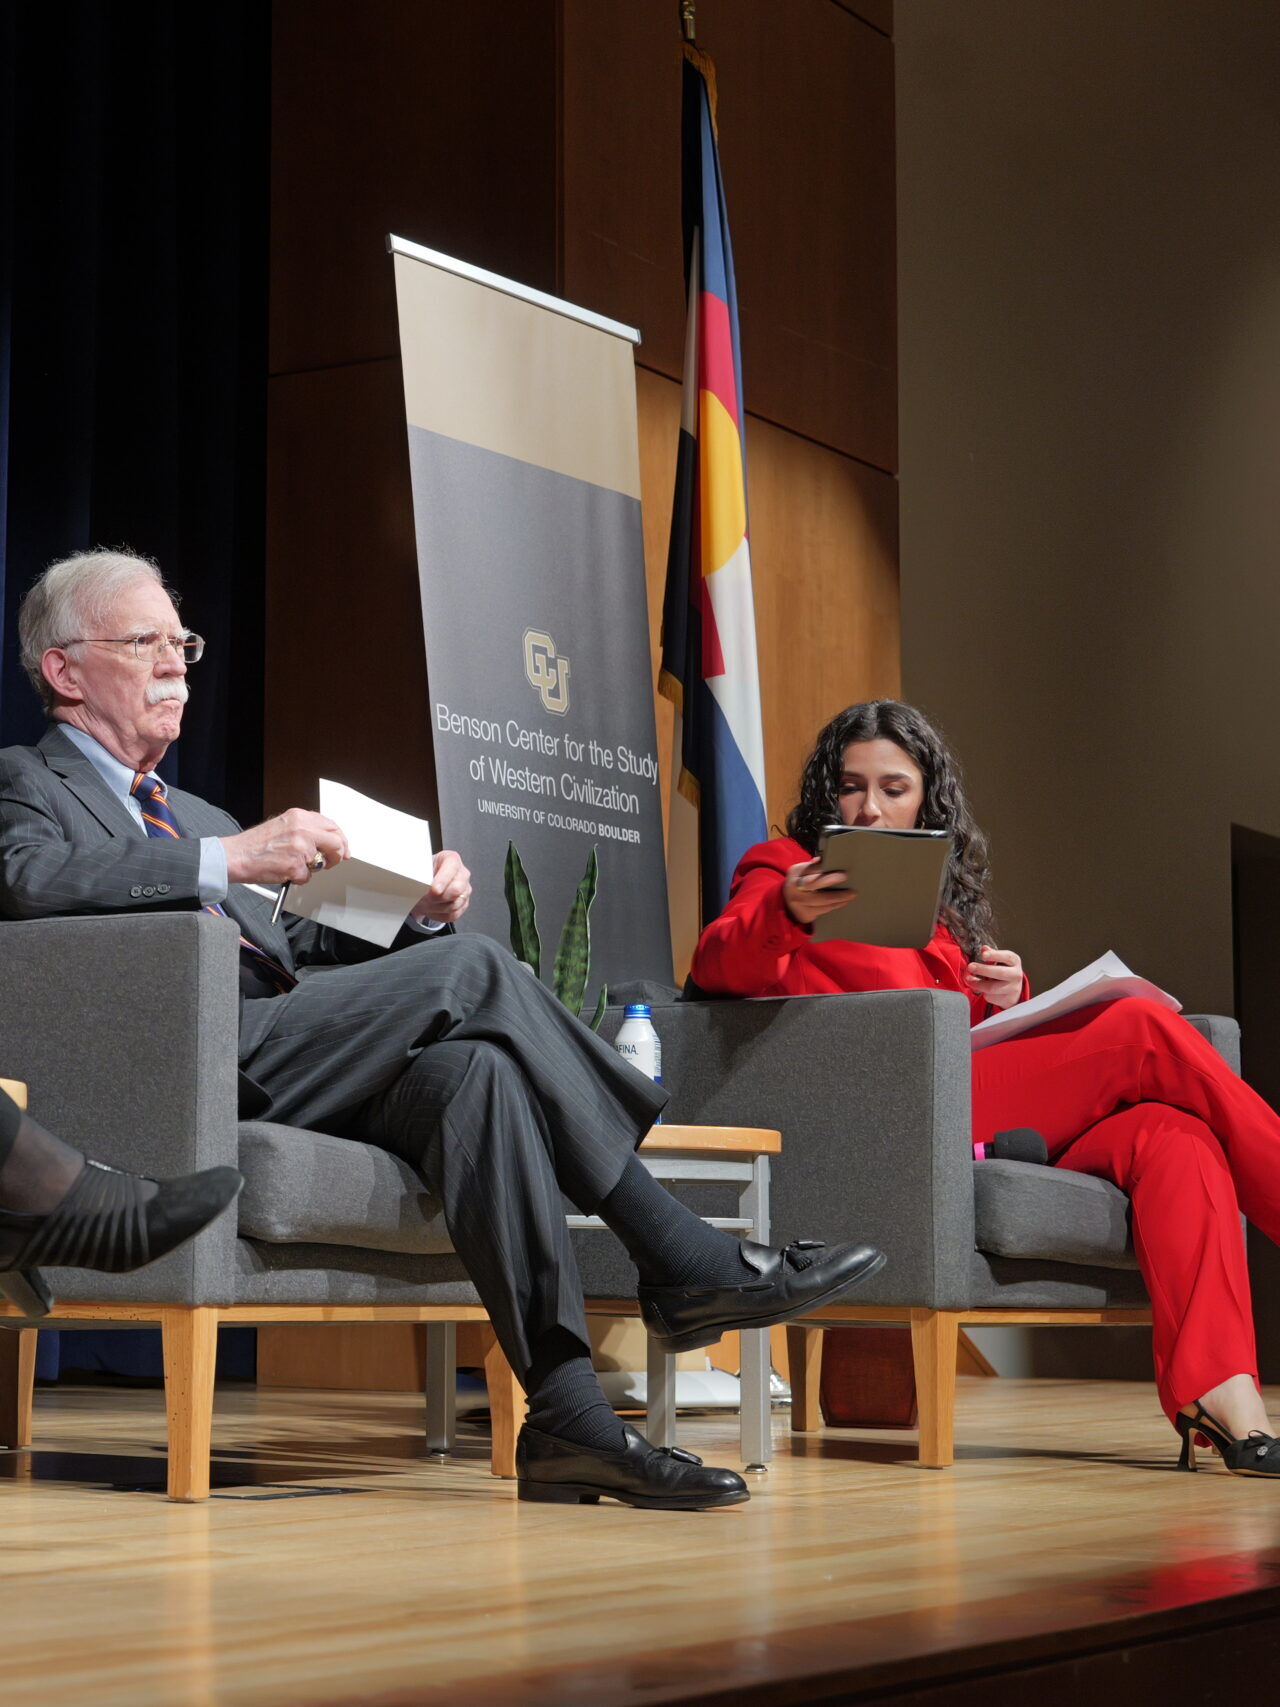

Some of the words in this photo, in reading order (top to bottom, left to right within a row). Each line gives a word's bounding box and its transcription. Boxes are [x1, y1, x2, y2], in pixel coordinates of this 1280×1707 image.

[523, 628, 569, 716] CU
[436, 703, 502, 744] Benson
[506, 720, 560, 757] Center
[563, 733, 585, 762] for
[588, 739, 614, 769] the
[617, 746, 658, 786] Study
[469, 755, 485, 782] of
[488, 757, 557, 797] Western
[560, 773, 640, 815] Civilization
[477, 799, 532, 822] UNIVERSITY
[533, 810, 546, 825] OF
[547, 813, 597, 835] COLORADO
[598, 823, 641, 844] BOULDER
